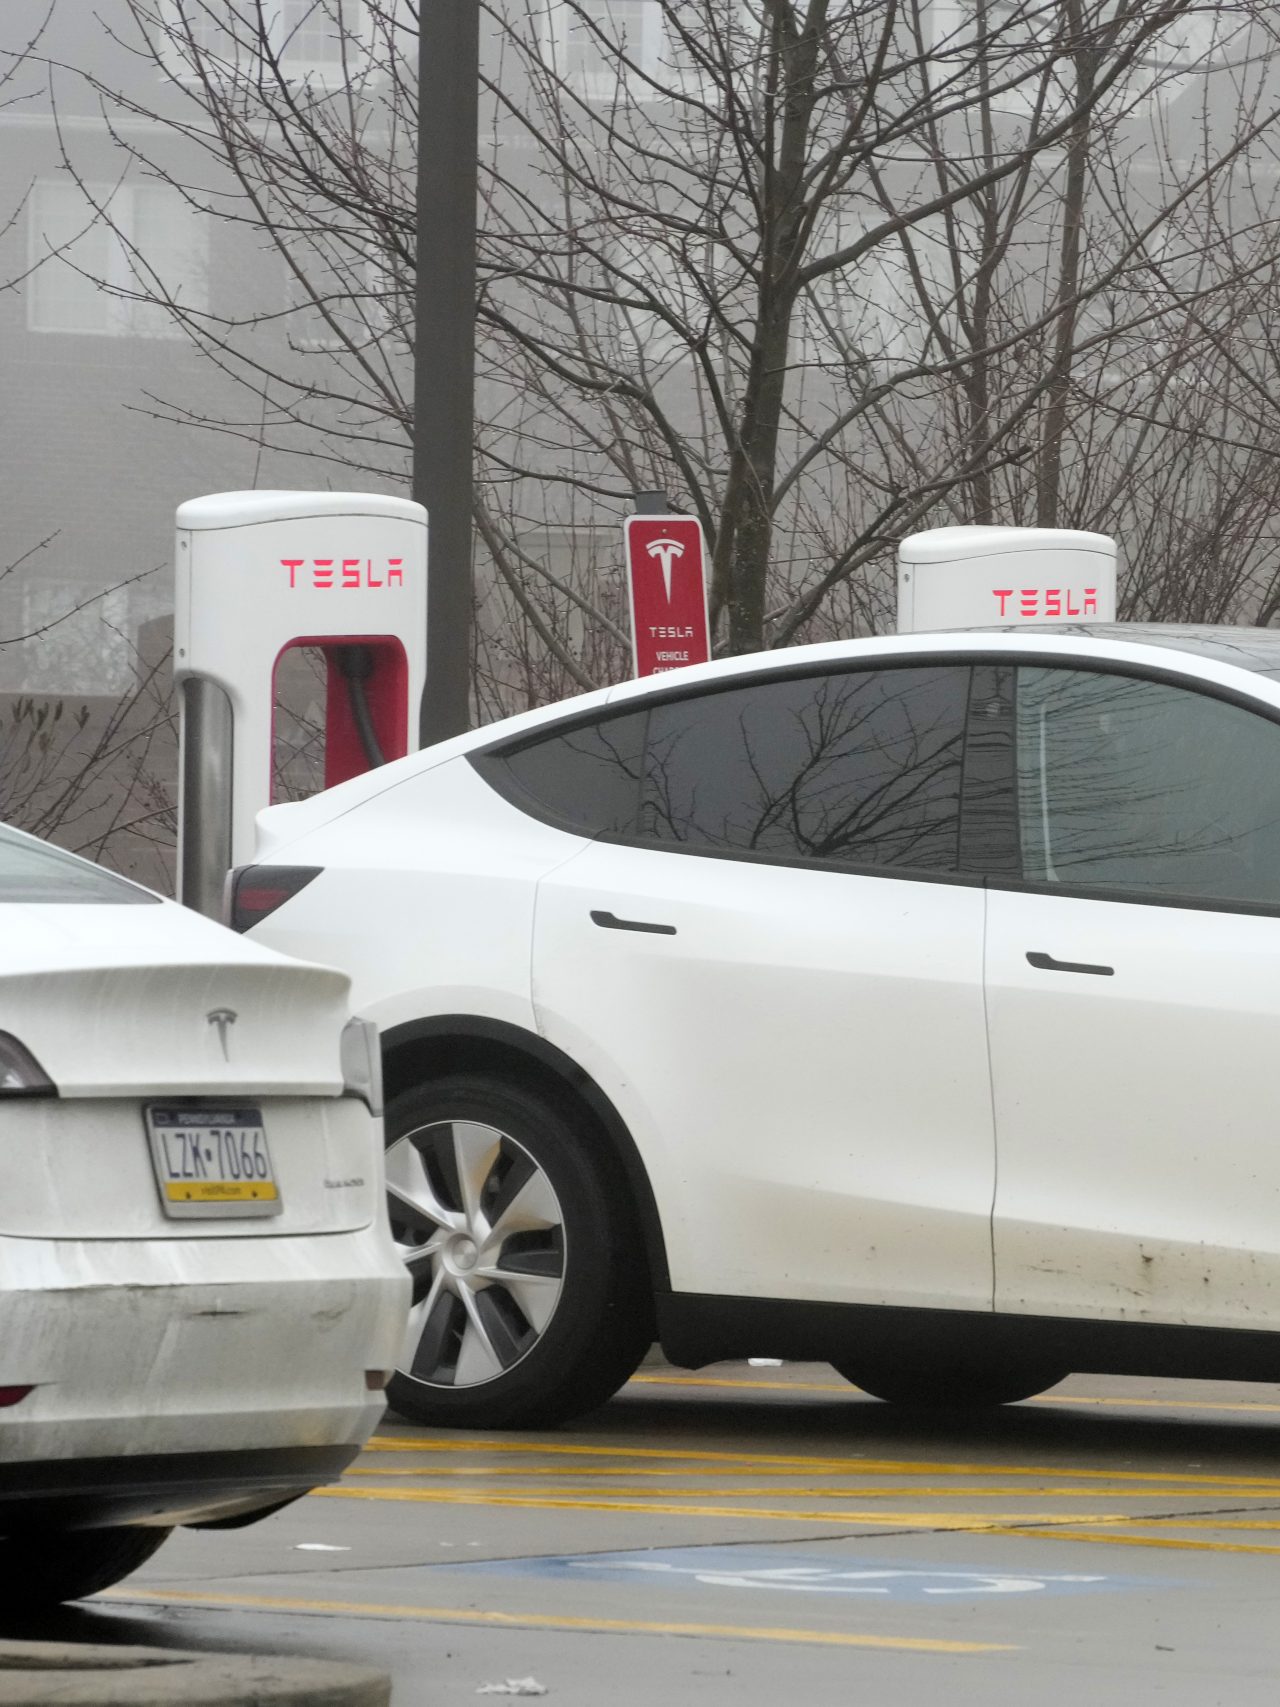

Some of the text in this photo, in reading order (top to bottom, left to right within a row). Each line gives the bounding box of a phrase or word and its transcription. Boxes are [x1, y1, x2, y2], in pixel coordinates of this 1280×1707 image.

[280, 559, 403, 588] TESLA
[992, 588, 1097, 616] TESLA
[649, 626, 693, 638] TESLA
[656, 650, 689, 661] VEHICLE
